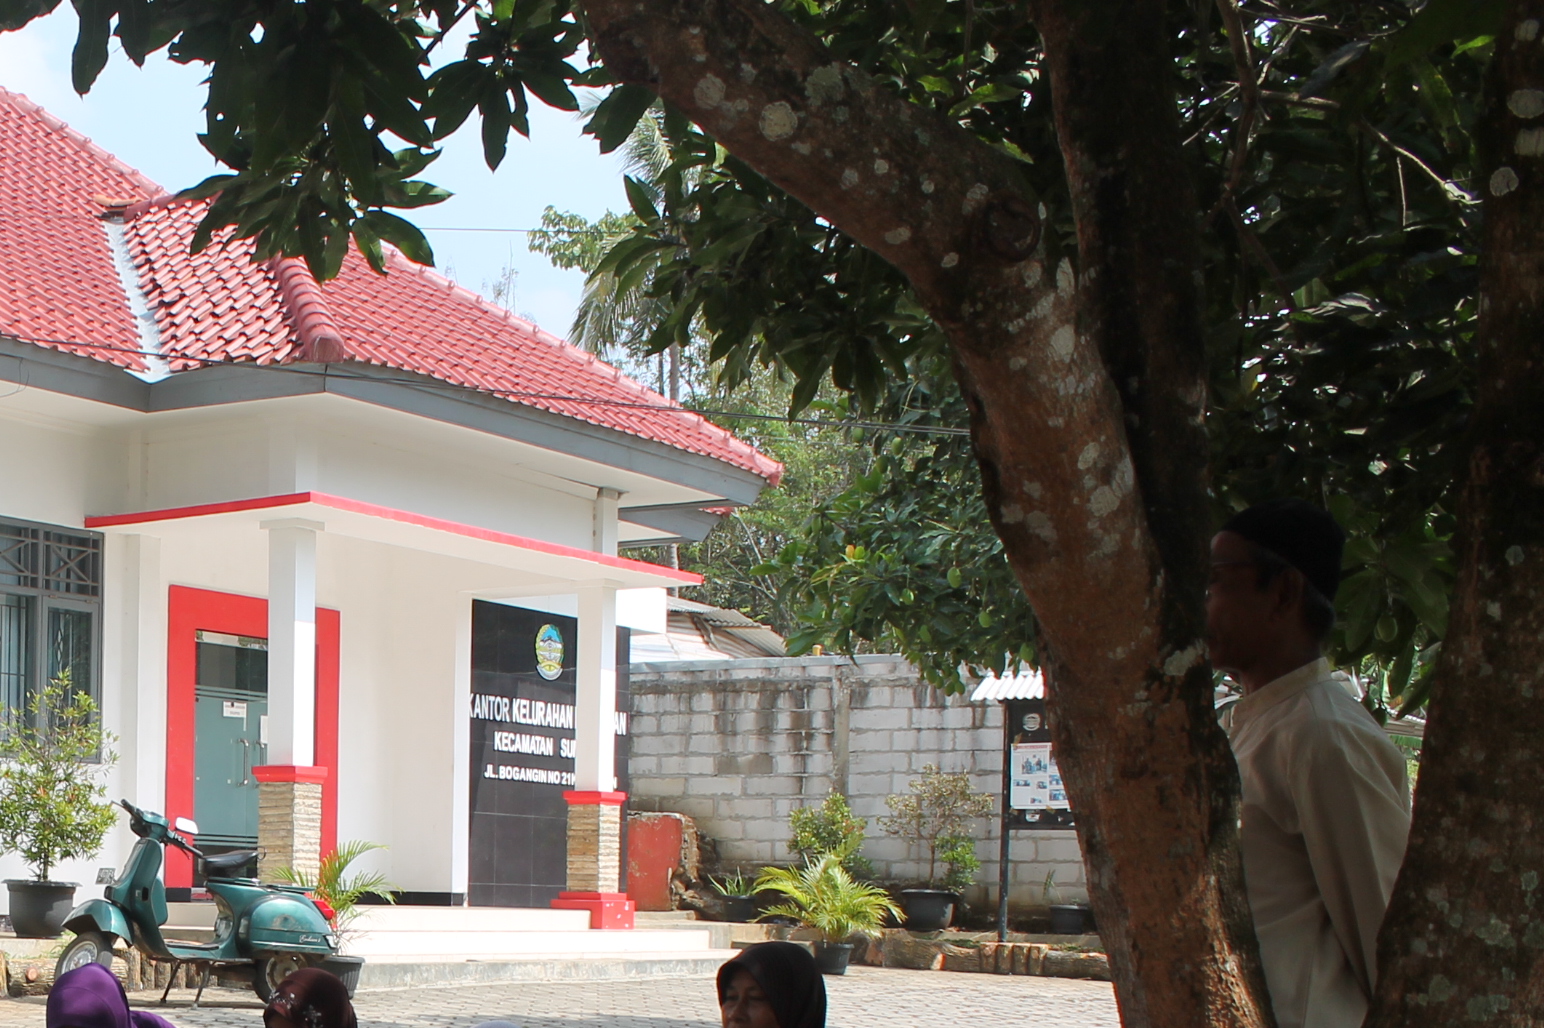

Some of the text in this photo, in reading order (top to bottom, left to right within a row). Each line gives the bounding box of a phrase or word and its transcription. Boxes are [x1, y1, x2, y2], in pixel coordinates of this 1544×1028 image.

[469, 693, 510, 722] KANTOR
[512, 698, 573, 729] KELURAHAN
[494, 731, 554, 756] KECAMATAN
[484, 764, 498, 778] JL.
[499, 766, 547, 783] BOGANGIN
[548, 770, 561, 784] NO
[561, 772, 571, 786] 21
